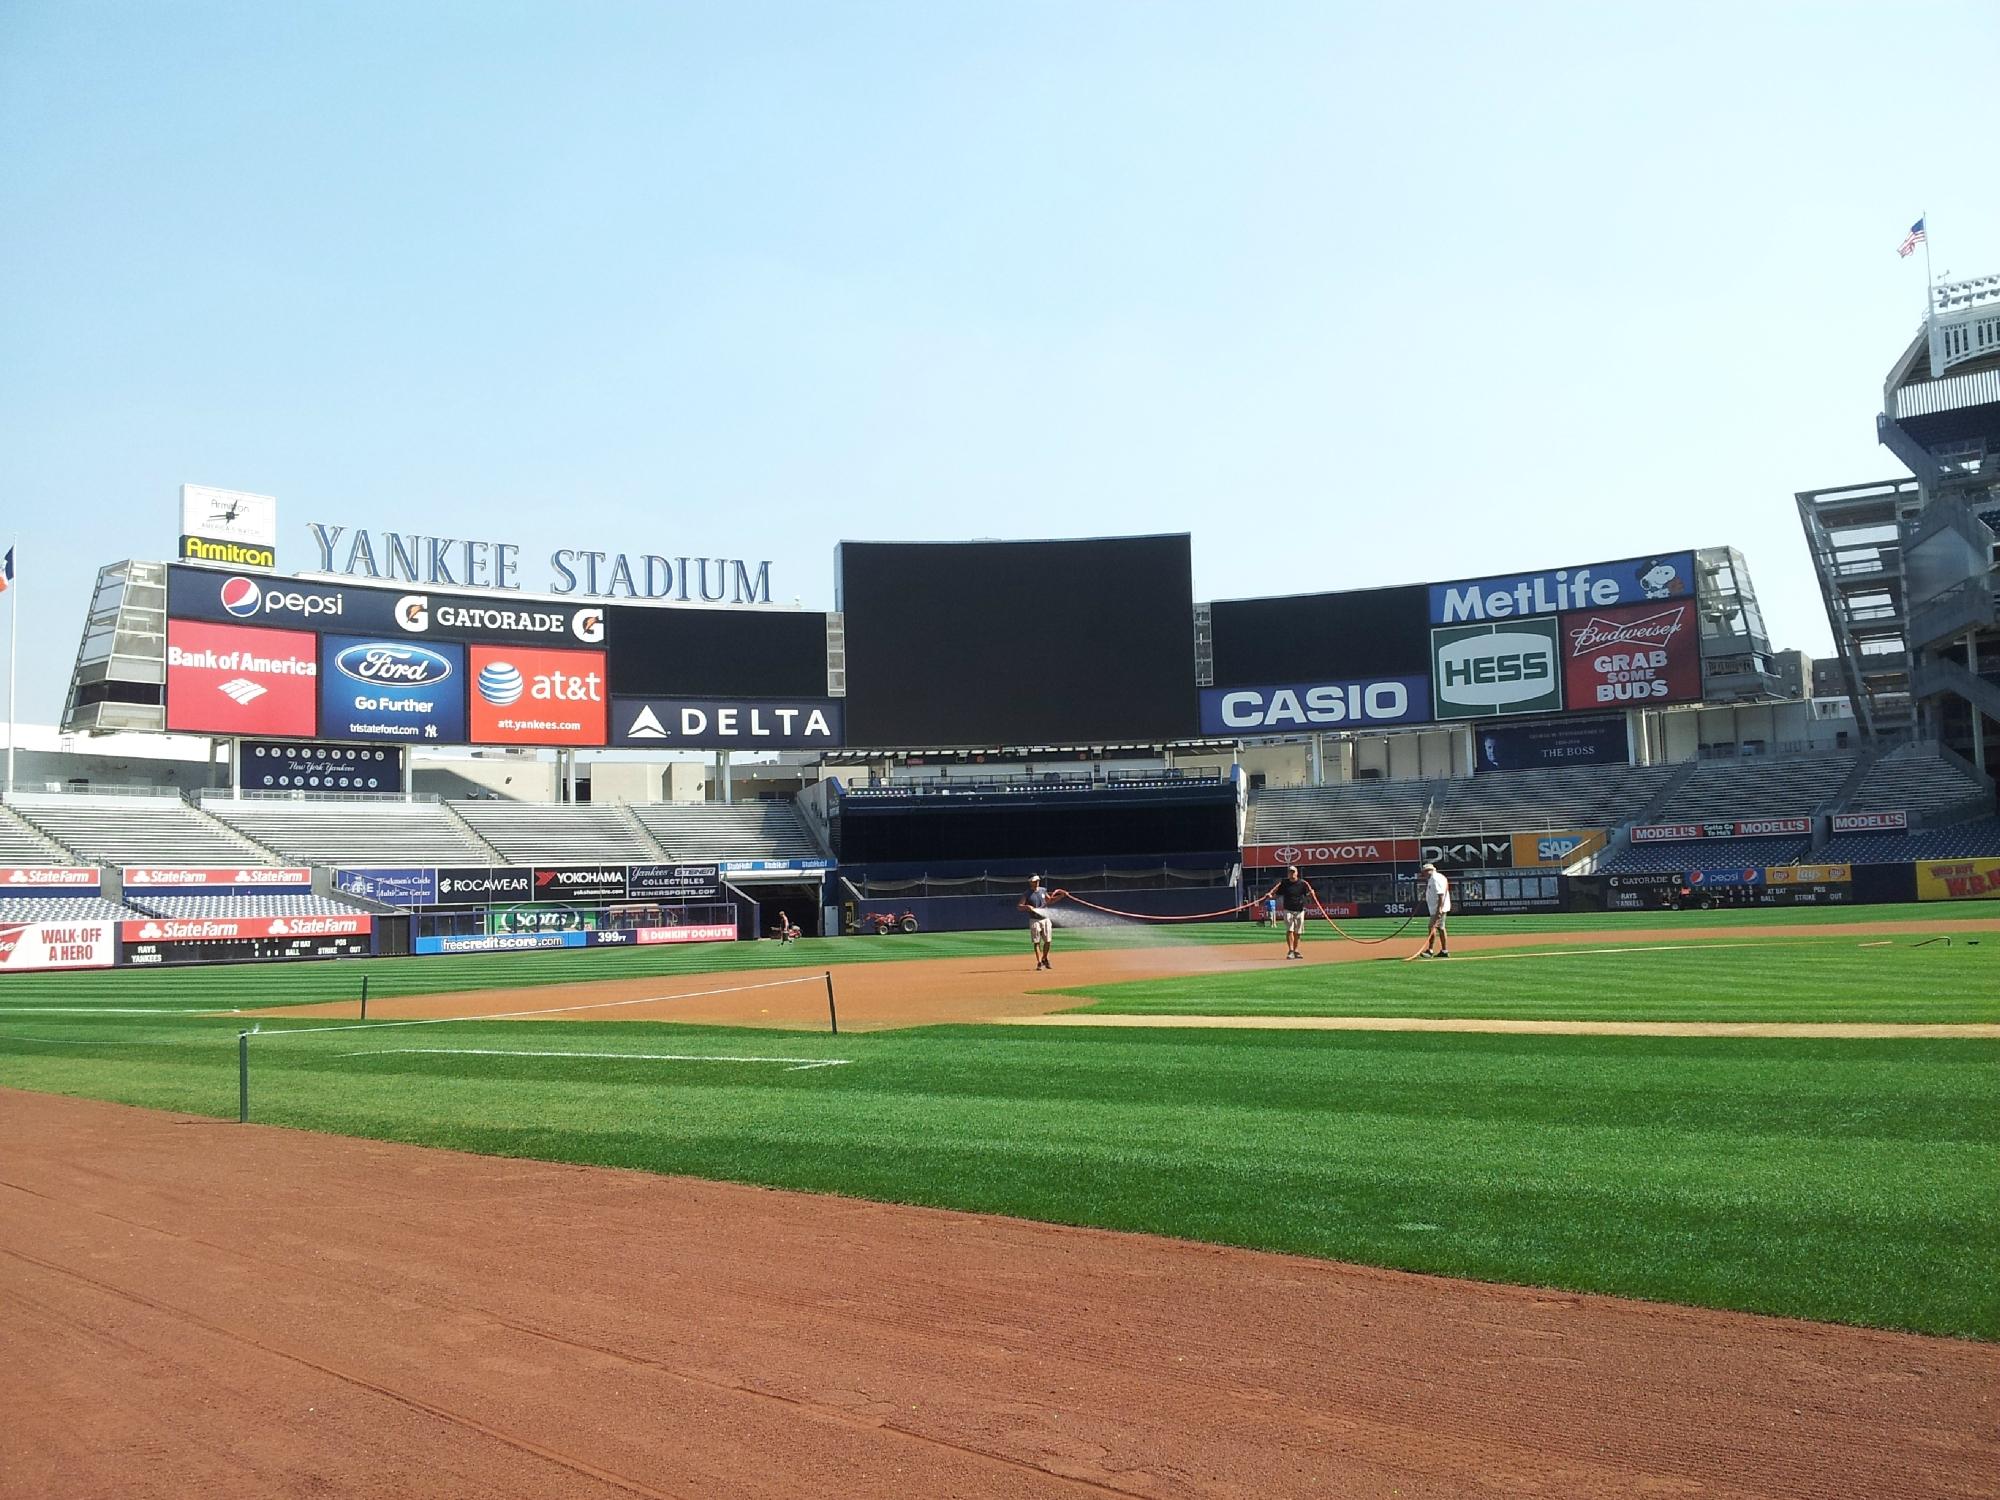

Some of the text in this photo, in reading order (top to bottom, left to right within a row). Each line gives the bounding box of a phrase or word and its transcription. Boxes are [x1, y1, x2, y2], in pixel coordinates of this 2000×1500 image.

[211, 499, 249, 513] Armion
[187, 537, 273, 566] Armitron
[306, 521, 773, 605] YANKEE STADIUM
[265, 591, 343, 616] pepsi
[1443, 570, 1619, 622] MetLife
[395, 595, 604, 643] G GATORADE G
[1570, 622, 1681, 647] Budweiser
[168, 646, 316, 675] Bank of America
[359, 649, 428, 680] Ford
[1594, 651, 1668, 673] GRAB
[1445, 651, 1548, 687] HESS
[1607, 670, 1656, 682] SOME
[531, 670, 601, 701] at&t
[1596, 680, 1668, 702] BUDS
[355, 696, 433, 712] Go Further
[1221, 682, 1408, 727] CASIO
[350, 723, 419, 735] tristateford.com
[498, 718, 580, 731] att.yankees.com
[681, 708, 830, 736] DELTA
[1543, 746, 1595, 758] THE BOSS
[288, 761, 355, 775] New York Yankees
[1740, 820, 1805, 833] MODELL'S
[1836, 815, 1904, 828] MODELL'S
[1636, 826, 1697, 839] MODELL'S
[1304, 846, 1379, 860] TOYOTA
[1421, 842, 1510, 863] DKNY
[1539, 840, 1572, 858] SAP
[557, 872, 623, 884] YOKOHAMA
[631, 866, 668, 881] Yankees
[1622, 876, 1668, 885] GATORADE
[1710, 873, 1738, 883] pepsi
[454, 879, 528, 891] ROCAWEAR
[692, 928, 733, 939] DONUTS
[443, 936, 562, 950] freecreditscore.com
[49, 945, 93, 960] A HERO
[131, 955, 162, 963] YANKEES
